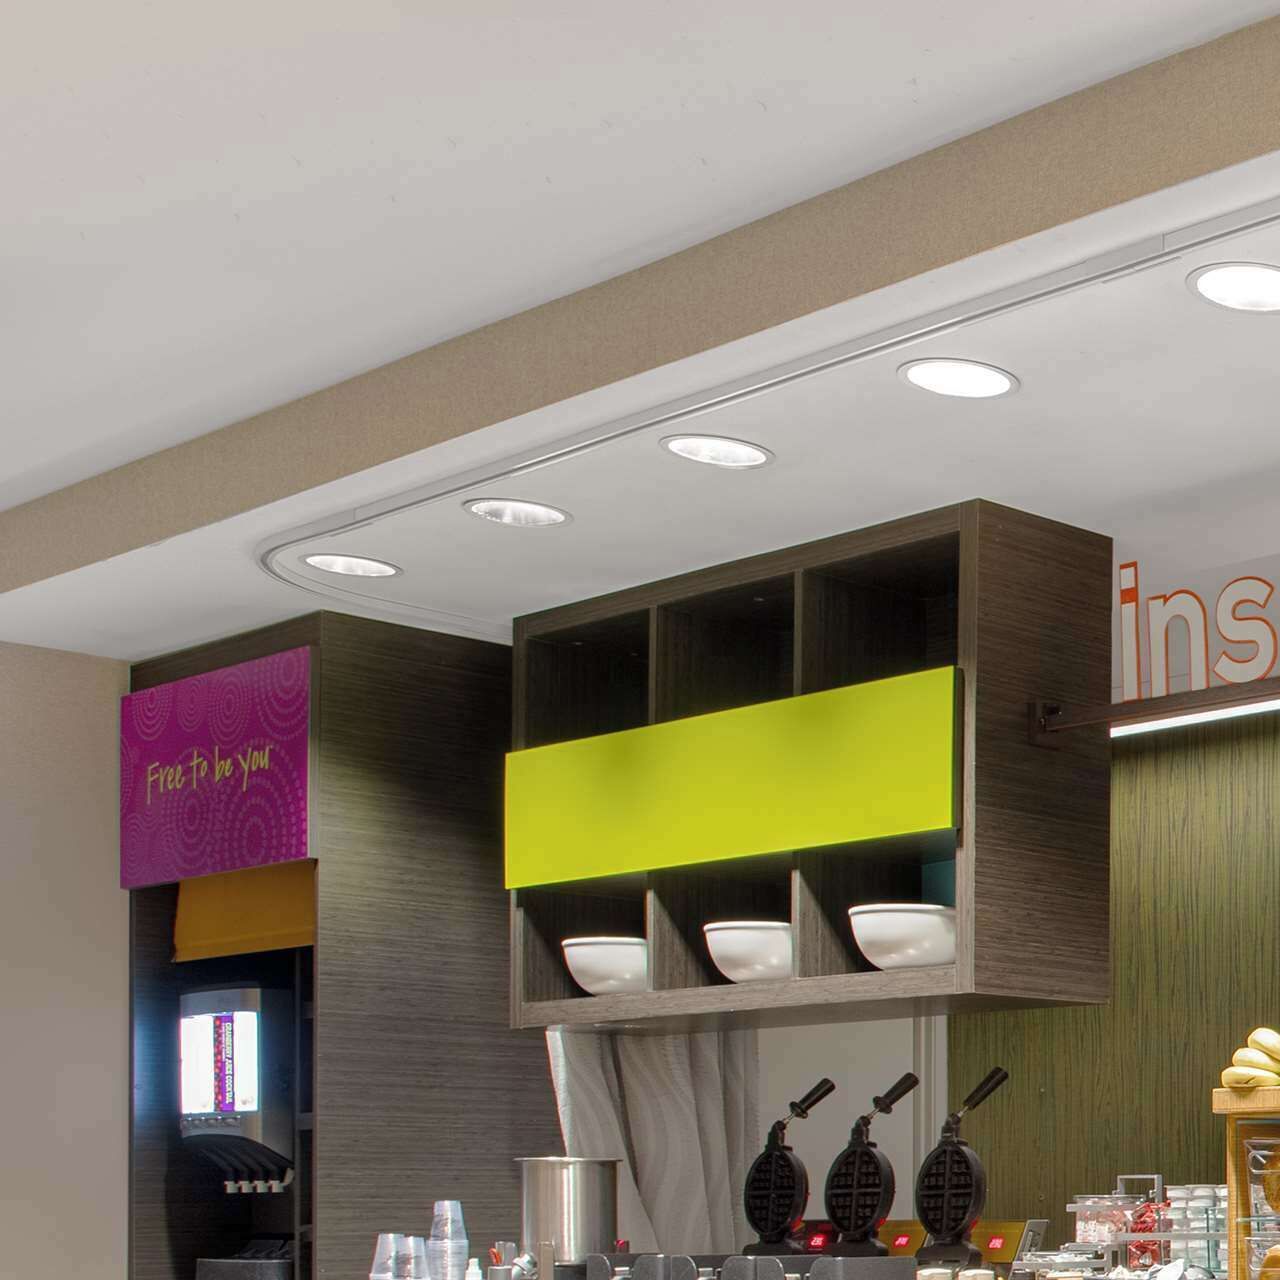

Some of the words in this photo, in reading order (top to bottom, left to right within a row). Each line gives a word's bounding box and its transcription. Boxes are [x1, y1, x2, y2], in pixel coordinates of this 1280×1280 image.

[147, 762, 185, 805] Free
[190, 750, 208, 789] to
[215, 745, 234, 783] be
[238, 745, 273, 792] you
